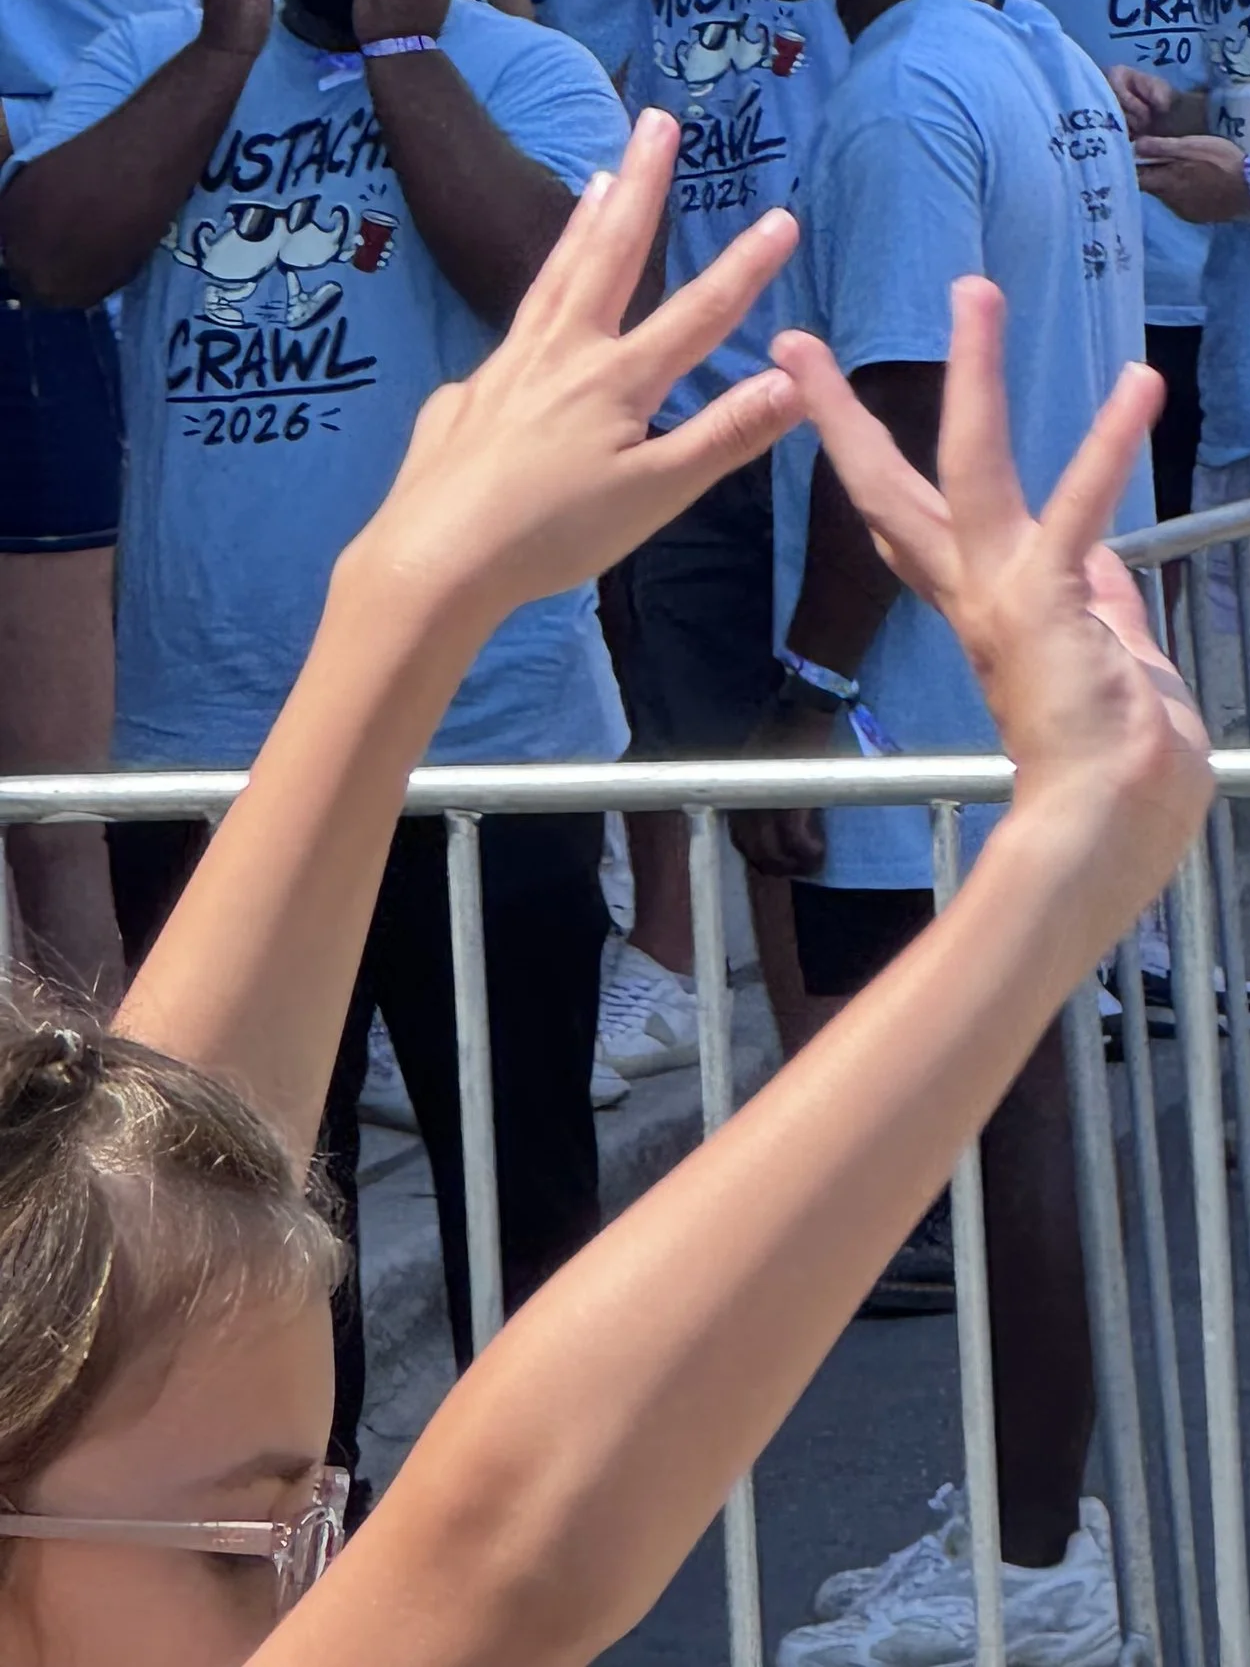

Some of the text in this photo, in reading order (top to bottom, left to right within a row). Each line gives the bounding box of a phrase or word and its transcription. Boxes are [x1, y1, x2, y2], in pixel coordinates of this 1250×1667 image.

[1153, 37, 1191, 67] 20
[200, 107, 393, 195] USTACH
[678, 106, 786, 169] RAWL
[166, 316, 378, 392] CRAWL
[202, 401, 311, 445] 2026
